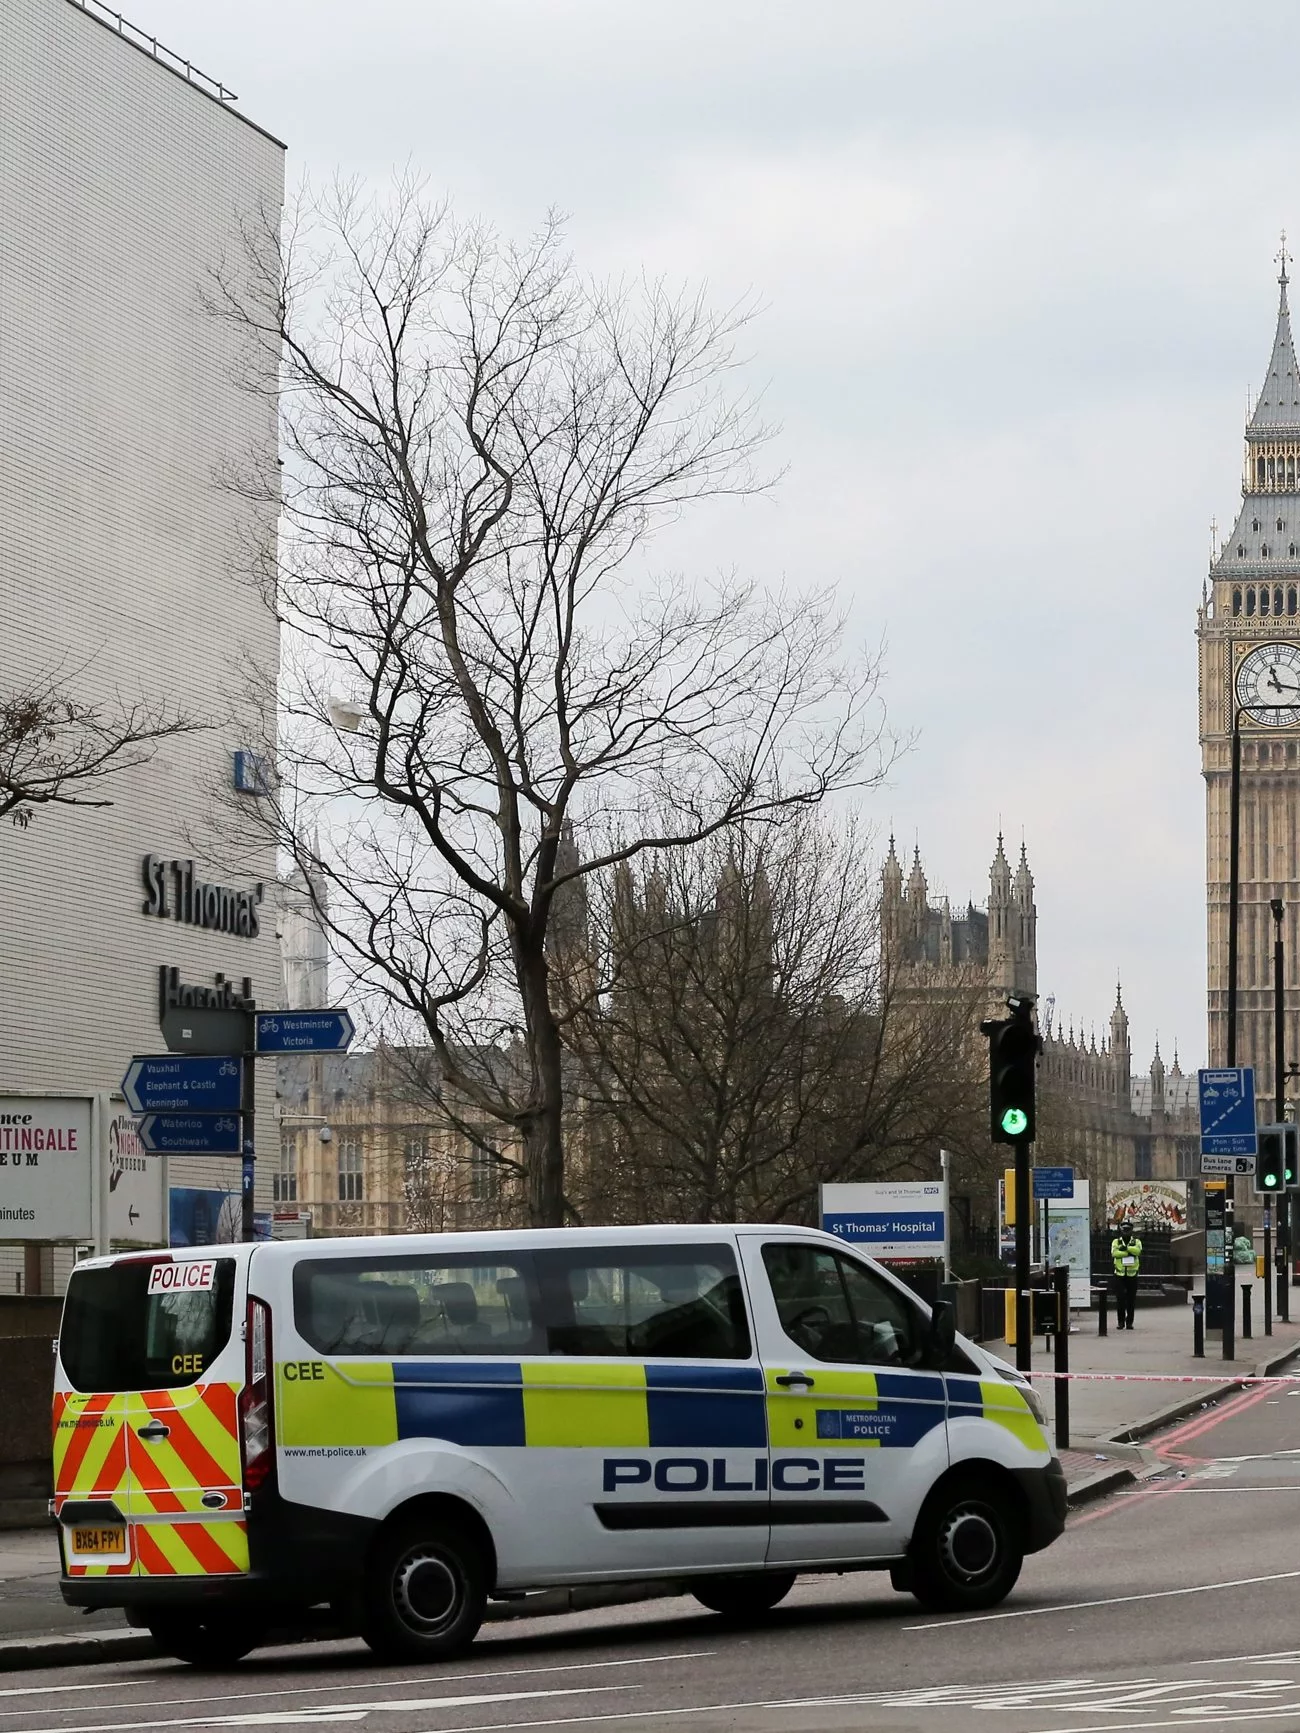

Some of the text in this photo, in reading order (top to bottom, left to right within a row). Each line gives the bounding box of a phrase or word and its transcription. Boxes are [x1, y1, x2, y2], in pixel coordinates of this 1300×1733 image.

[142, 853, 170, 918] St
[282, 1019, 333, 1030] Westminster
[282, 1036, 313, 1046] Victoria
[146, 1064, 180, 1074] Vauxhall
[146, 1080, 217, 1091] Elephant & Castle
[146, 1098, 189, 1109] Kennington
[161, 1118, 203, 1129] Waterloo
[0, 1127, 78, 1151] TINGALE
[161, 1136, 210, 1147] Southwark
[119, 1157, 147, 1172] MUSEUM
[1203, 1156, 1232, 1165] Bus lane
[832, 1221, 936, 1235] St Thomas' Hospital
[150, 1263, 213, 1290] POLICE
[171, 1354, 203, 1375] CEE
[283, 1361, 325, 1381] CEE
[845, 1414, 897, 1423] METROPOLITAN
[853, 1425, 891, 1434] POLICE
[284, 1447, 367, 1458] www.met.police.uk
[603, 1458, 866, 1492] POLICE
[75, 1530, 120, 1550] BX64 FPY
